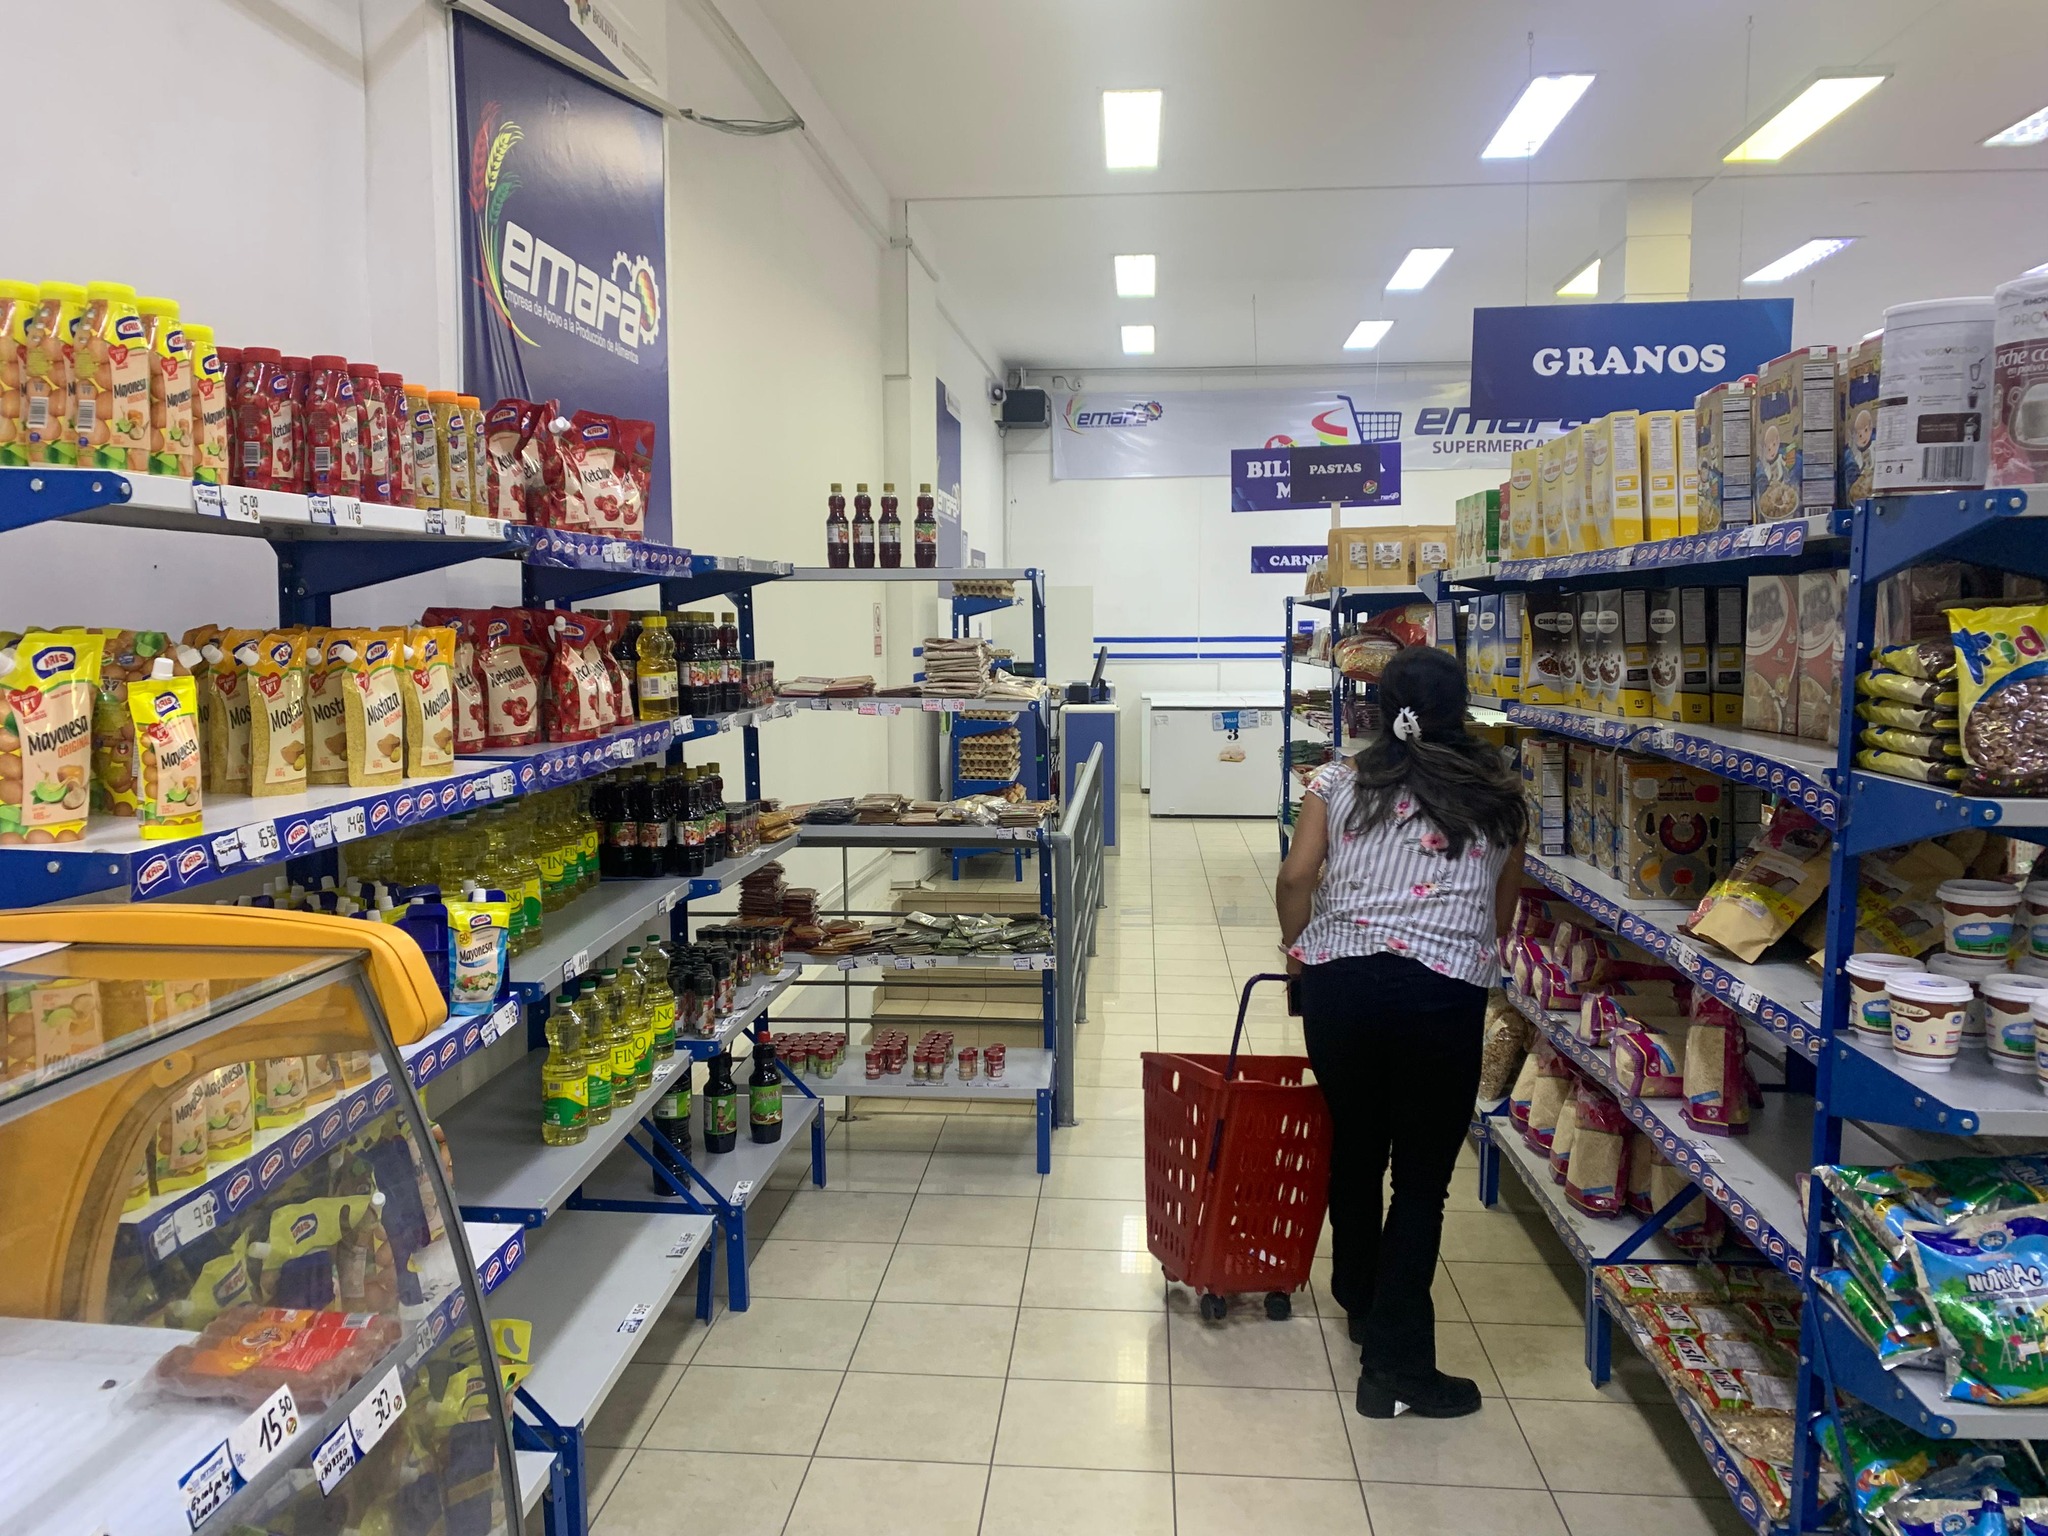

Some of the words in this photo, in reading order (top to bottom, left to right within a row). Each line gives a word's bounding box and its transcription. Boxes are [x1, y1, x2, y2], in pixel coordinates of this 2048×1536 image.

[502, 220, 642, 349] emapa
[504, 283, 533, 312] Empresa
[533, 303, 543, 318] de
[543, 306, 563, 328] Apoyo
[1532, 344, 1727, 376] GRANOS
[1995, 350, 2029, 370] eche
[1077, 411, 1148, 425] emapa
[1432, 438, 1554, 454] SUPERMERCA
[1308, 463, 1362, 475] PASTAS
[565, 626, 579, 634] RIS
[44, 653, 69, 668] KRIS
[490, 665, 526, 688] Ketchup
[366, 692, 400, 726] Mostaza
[422, 688, 451, 720] Mostaza
[28, 715, 89, 756] Mayonesa
[1227, 728, 1239, 741] 3
[289, 827, 306, 841] KRIS
[183, 851, 202, 870] KRIS
[541, 854, 563, 870] FIN
[145, 863, 165, 881] KRIS
[459, 941, 494, 961] Mayonesa
[614, 1048, 635, 1065] FIN
[376, 1085, 390, 1102] KRIS
[351, 1100, 366, 1119] KRIS
[323, 1116, 340, 1133] KRIS
[293, 1135, 310, 1157] KRIS
[265, 1156, 281, 1175] KRIS
[231, 1177, 248, 1200] KRIS
